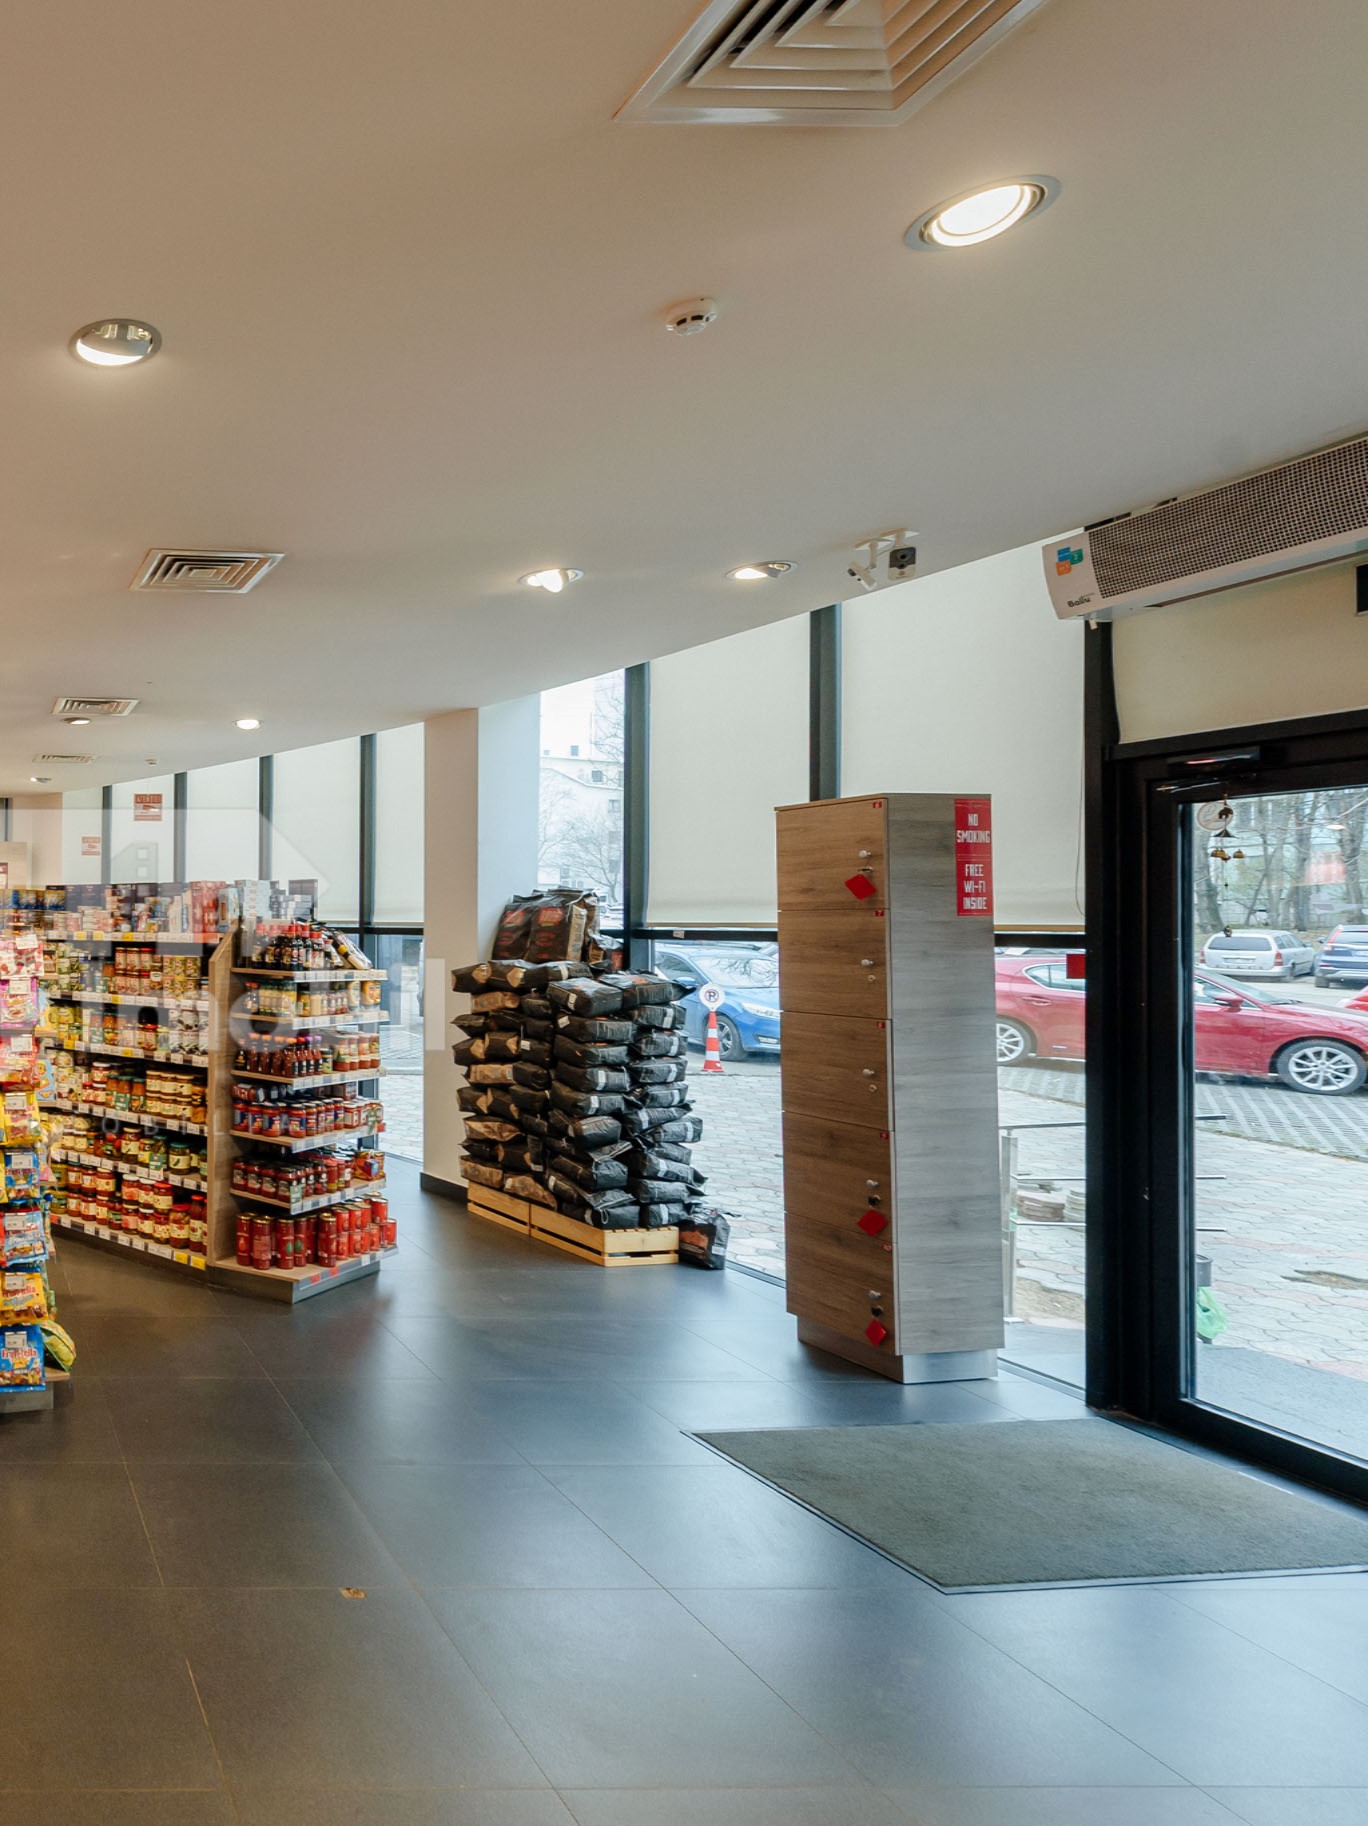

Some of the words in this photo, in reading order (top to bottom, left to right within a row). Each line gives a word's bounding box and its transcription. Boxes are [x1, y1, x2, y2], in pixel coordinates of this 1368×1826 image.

[968, 813, 978, 826] NO
[957, 830, 990, 843] SMOKING
[965, 864, 984, 876] FREE
[964, 880, 986, 893] WI-FI
[963, 897, 987, 909] INSIDE
